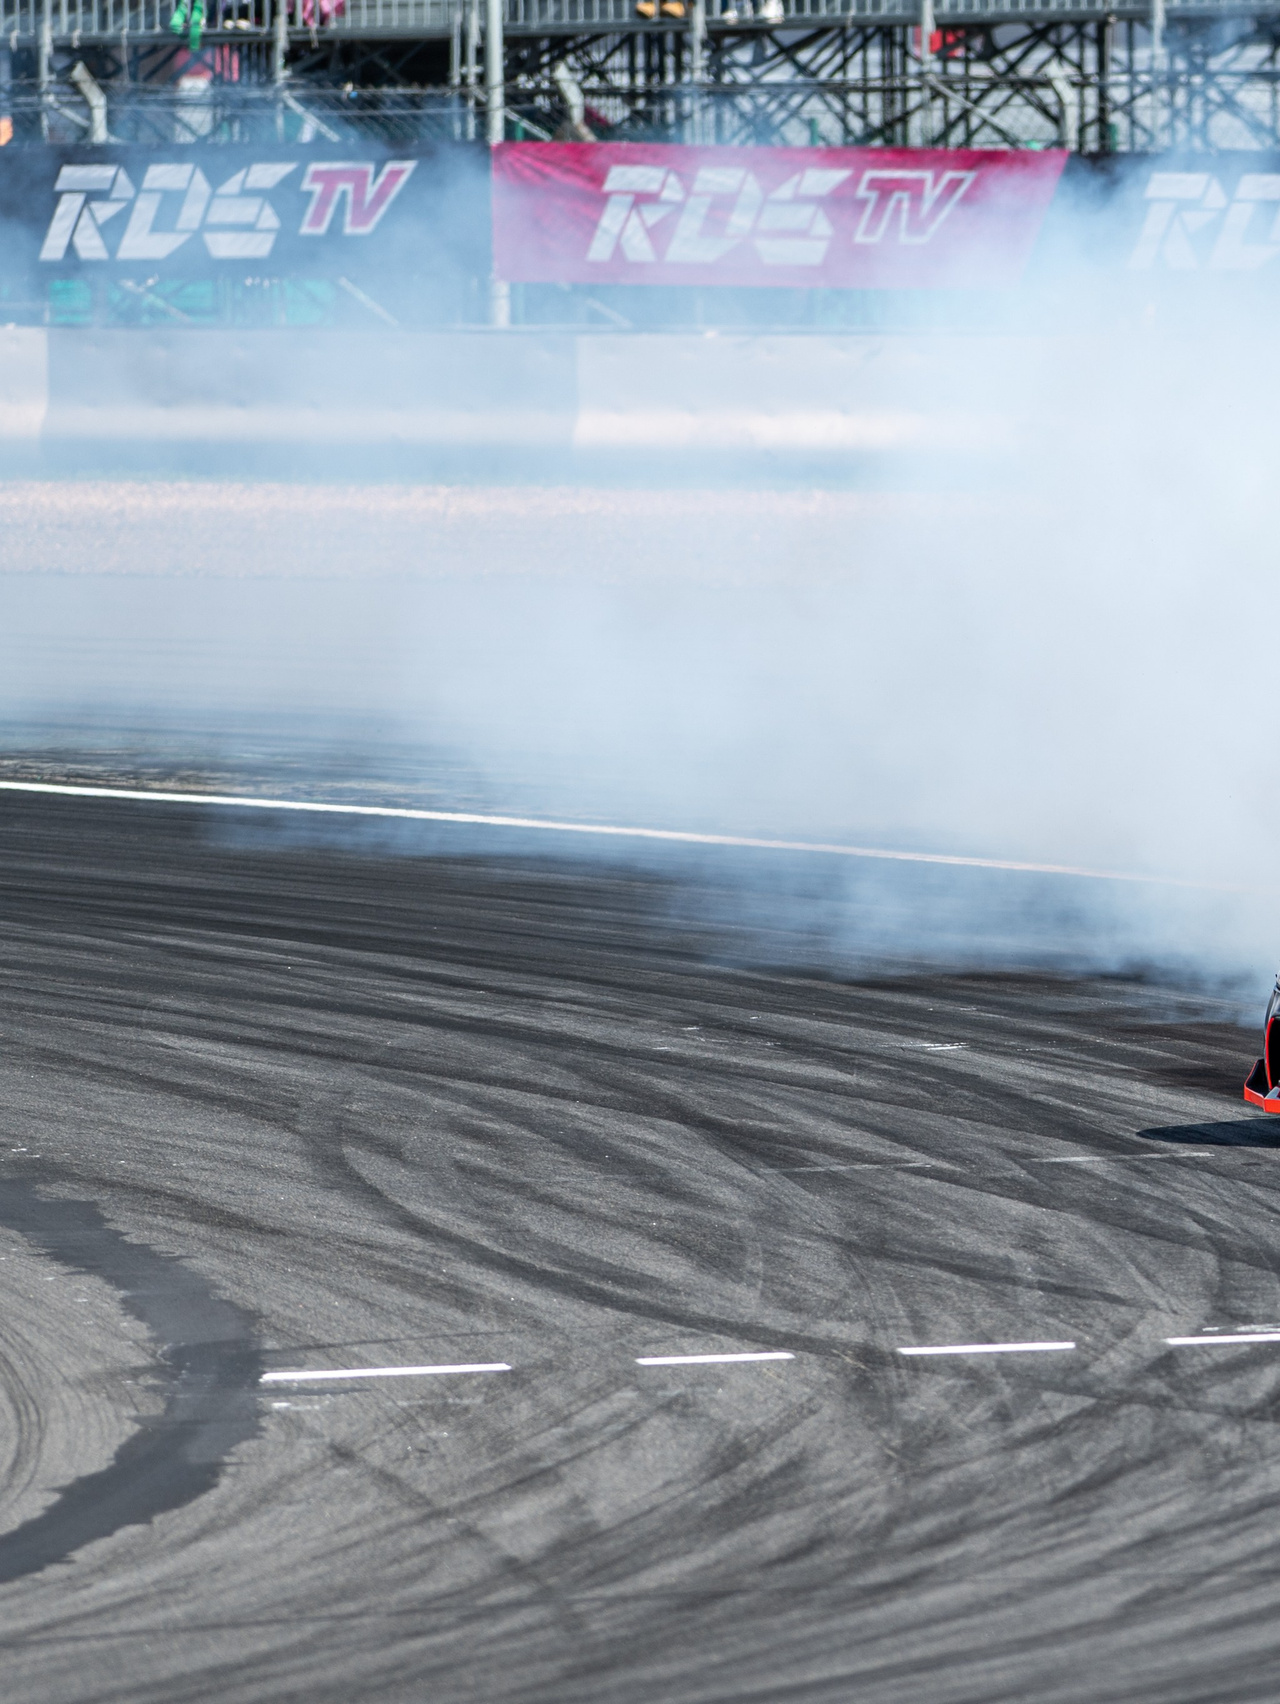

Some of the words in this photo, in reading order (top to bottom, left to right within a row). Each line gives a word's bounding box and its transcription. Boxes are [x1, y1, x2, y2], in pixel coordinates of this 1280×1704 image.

[39, 161, 299, 262] RDS
[299, 159, 418, 236] TV
[587, 164, 856, 264] RDS
[853, 169, 976, 245] TV
